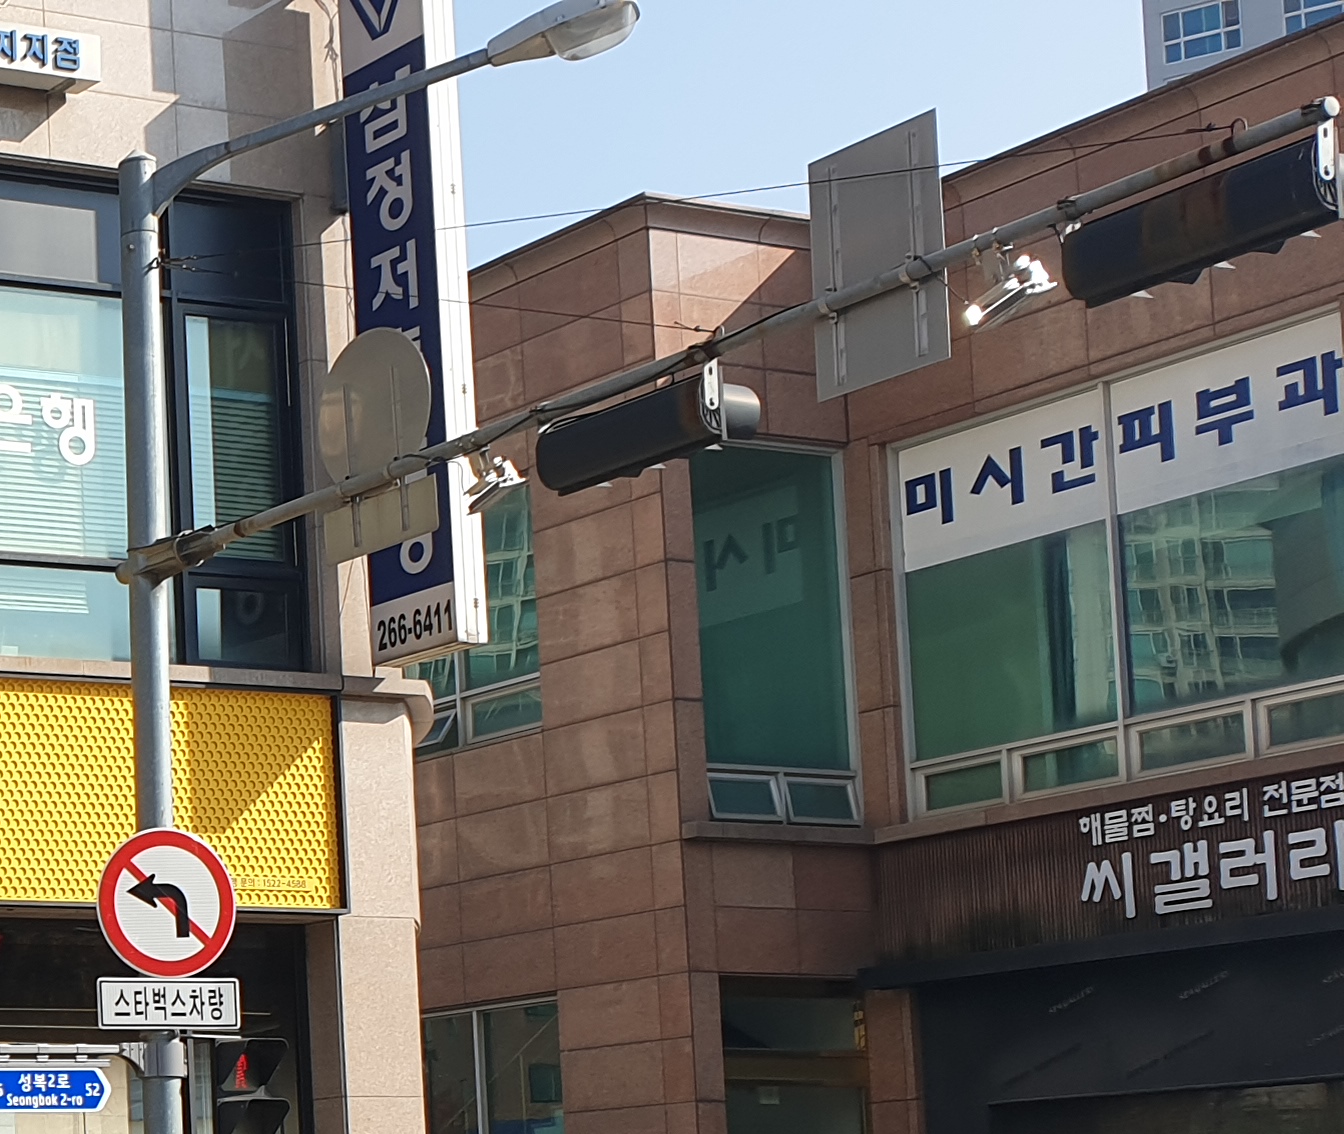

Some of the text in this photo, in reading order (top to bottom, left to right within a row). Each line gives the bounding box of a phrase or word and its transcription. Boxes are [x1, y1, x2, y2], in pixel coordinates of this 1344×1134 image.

[377, 598, 453, 652] 266-6411
[1262, 772, 1344, 818] 전문점
[113, 986, 225, 1021] 스타벅스차량
[18, 1073, 71, 1092] 성복2로
[85, 1083, 101, 1096] 52
[6, 1093, 83, 1108] Seongbok 2-ro
